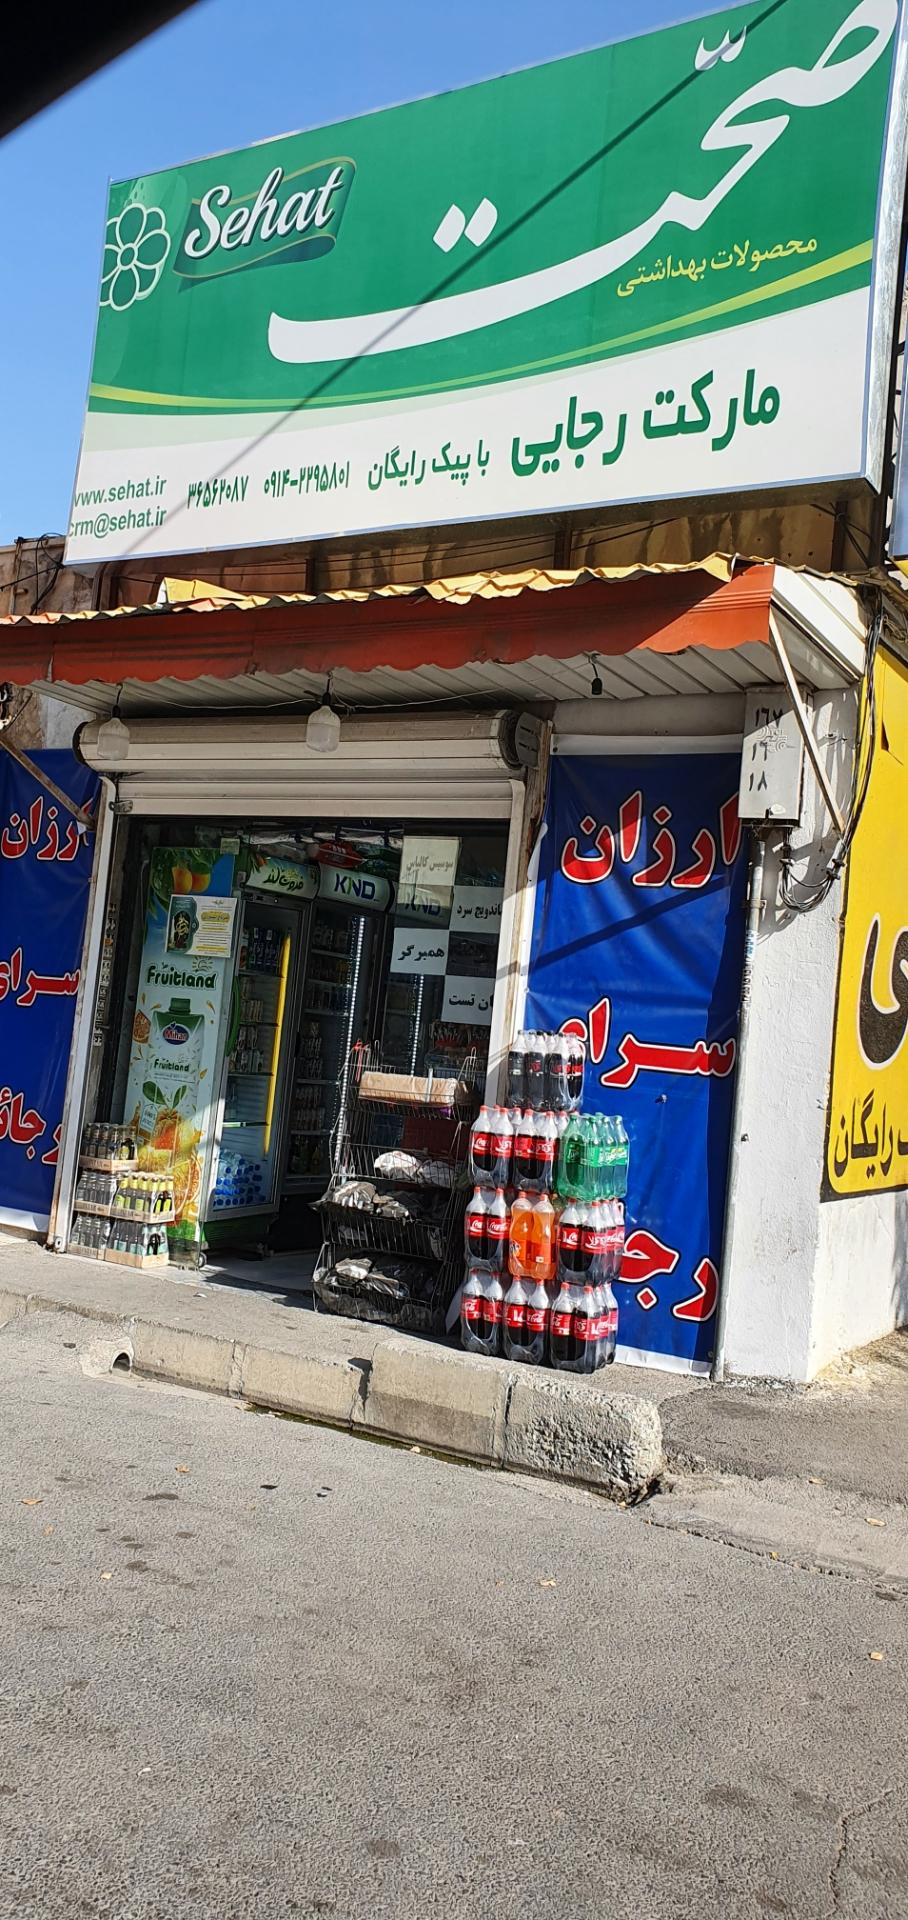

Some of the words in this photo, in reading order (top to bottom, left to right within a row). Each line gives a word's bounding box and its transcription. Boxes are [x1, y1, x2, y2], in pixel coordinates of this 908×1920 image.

[184, 167, 344, 259] Sehat
[712, 236, 818, 272] محصولات
[616, 256, 706, 297] بهداشتی
[643, 369, 781, 450] مارکت
[477, 439, 490, 476] با
[511, 397, 627, 477] رجایی
[367, 446, 426, 490] رایگان
[431, 442, 471, 486] پیک
[560, 790, 742, 889] ارزان
[146, 965, 218, 990] Fruitland
[449, 993, 476, 1006] تست
[478, 994, 494, 1011] ان
[833, 1088, 894, 1179] رایگان
